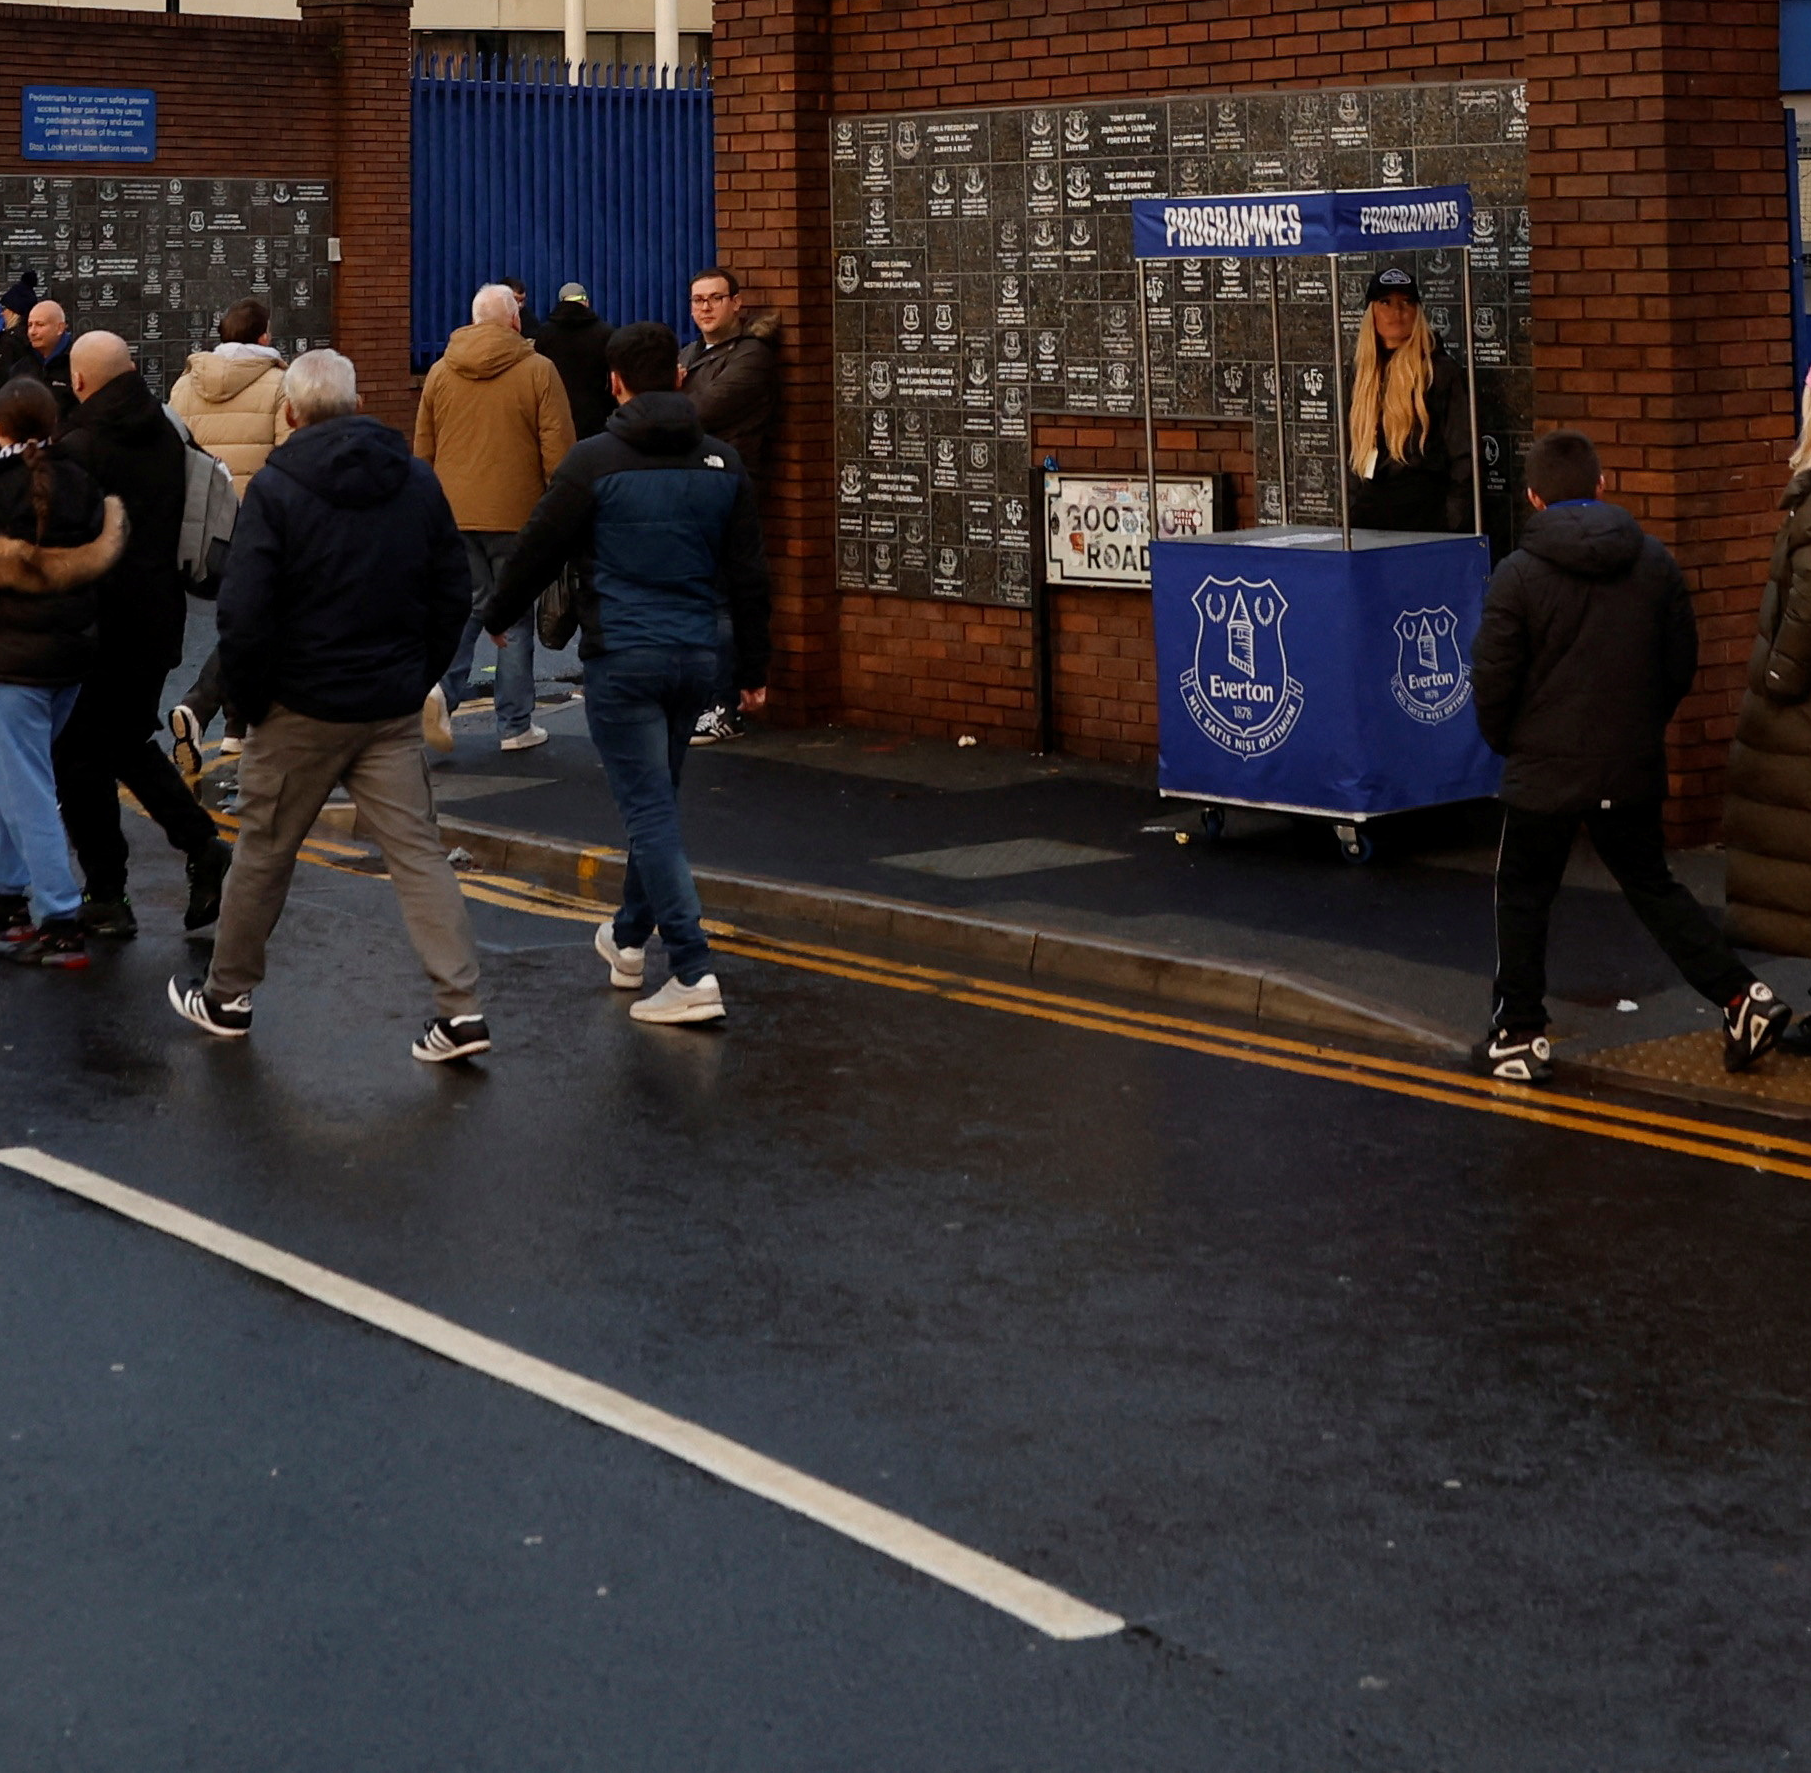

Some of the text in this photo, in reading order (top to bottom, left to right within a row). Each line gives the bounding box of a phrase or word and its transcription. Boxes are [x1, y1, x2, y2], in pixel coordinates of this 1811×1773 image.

[68, 94, 77, 103] for
[79, 96, 93, 104] your
[94, 96, 108, 104] own
[109, 95, 128, 105] safety
[61, 106, 71, 114] the
[84, 107, 98, 115] park
[115, 107, 124, 116] by
[110, 118, 122, 126] and
[99, 128, 106, 136] of
[1107, 136, 1131, 144] FOREVER
[65, 143, 78, 152] and
[1065, 143, 1089, 152] Everton
[1127, 182, 1151, 190] FOREVER
[1360, 200, 1460, 235] PROGRAMMES
[1164, 203, 1302, 248] PROGRAMMES
[1088, 544, 1151, 571] ROAD
[1408, 671, 1454, 690] Everton
[1210, 674, 1274, 704] Everton
[1396, 690, 1407, 707] NIL
[1443, 681, 1471, 718] OPTIMUM
[1233, 705, 1253, 721] 1878
[1188, 694, 1297, 753] NIL SATIS NISI OPTIMUM
